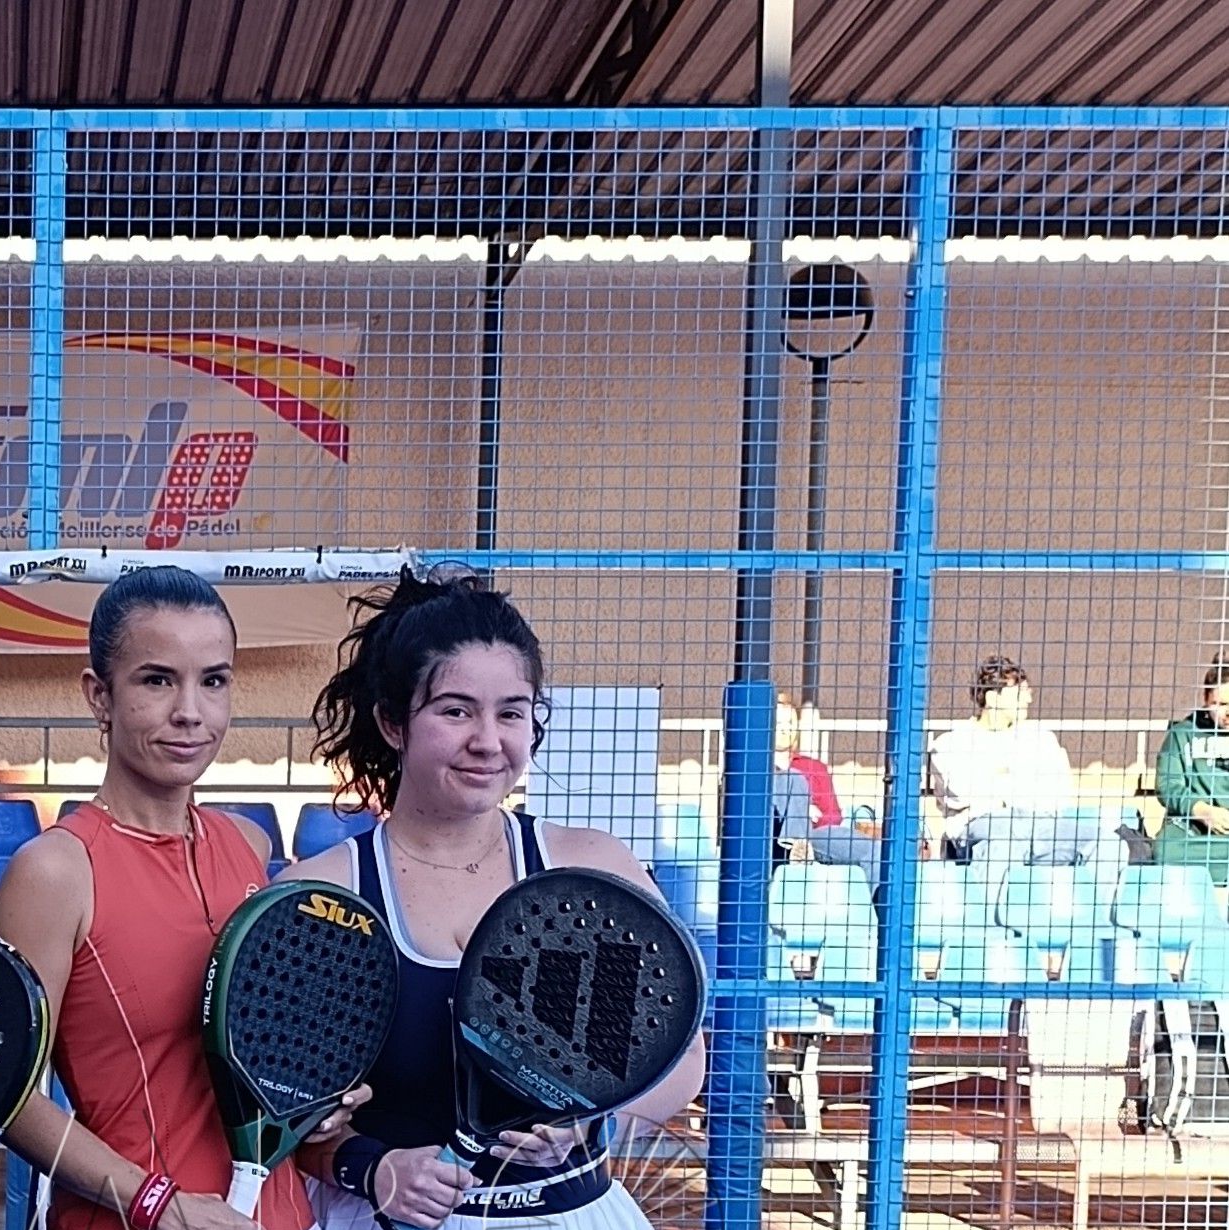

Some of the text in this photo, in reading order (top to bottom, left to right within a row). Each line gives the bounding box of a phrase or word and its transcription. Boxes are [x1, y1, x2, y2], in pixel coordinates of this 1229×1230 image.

[154, 517, 179, 538] de
[186, 517, 241, 537] Pádel
[298, 893, 374, 937] SIUX
[203, 957, 219, 1026] TRILOGY
[257, 1078, 294, 1095] TRILOGY
[516, 1071, 566, 1109] ORTEGA
[519, 1064, 573, 1106] MARTITA
